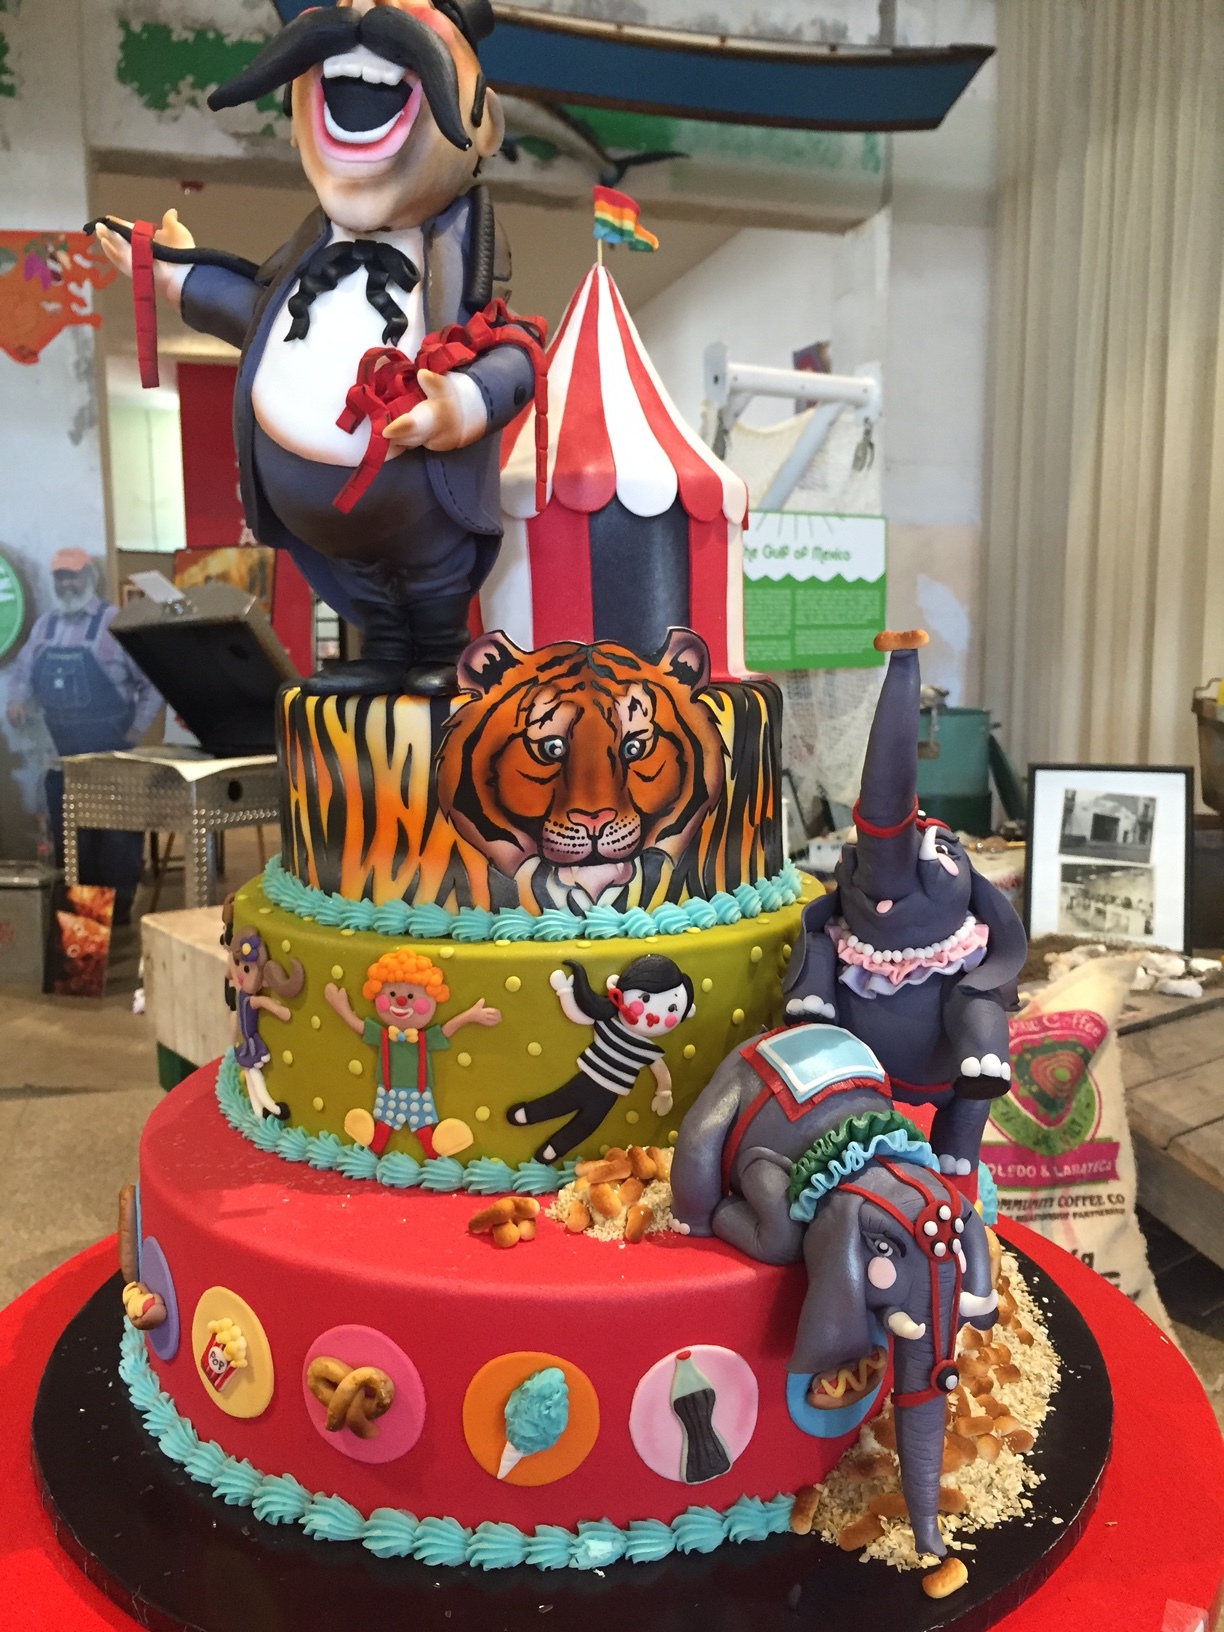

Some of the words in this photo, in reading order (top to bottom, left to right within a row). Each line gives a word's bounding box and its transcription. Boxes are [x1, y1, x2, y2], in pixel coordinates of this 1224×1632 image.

[743, 544, 758, 563] he
[762, 544, 789, 560] Gulf
[793, 545, 808, 560] of
[811, 545, 851, 564] Mexico
[987, 1163, 1037, 1178] OLEDO
[1040, 1164, 1051, 1178] &
[997, 1197, 1055, 1211] MMUNITY
[1057, 1194, 1106, 1208] COFFEE
[210, 1351, 225, 1371] POP
